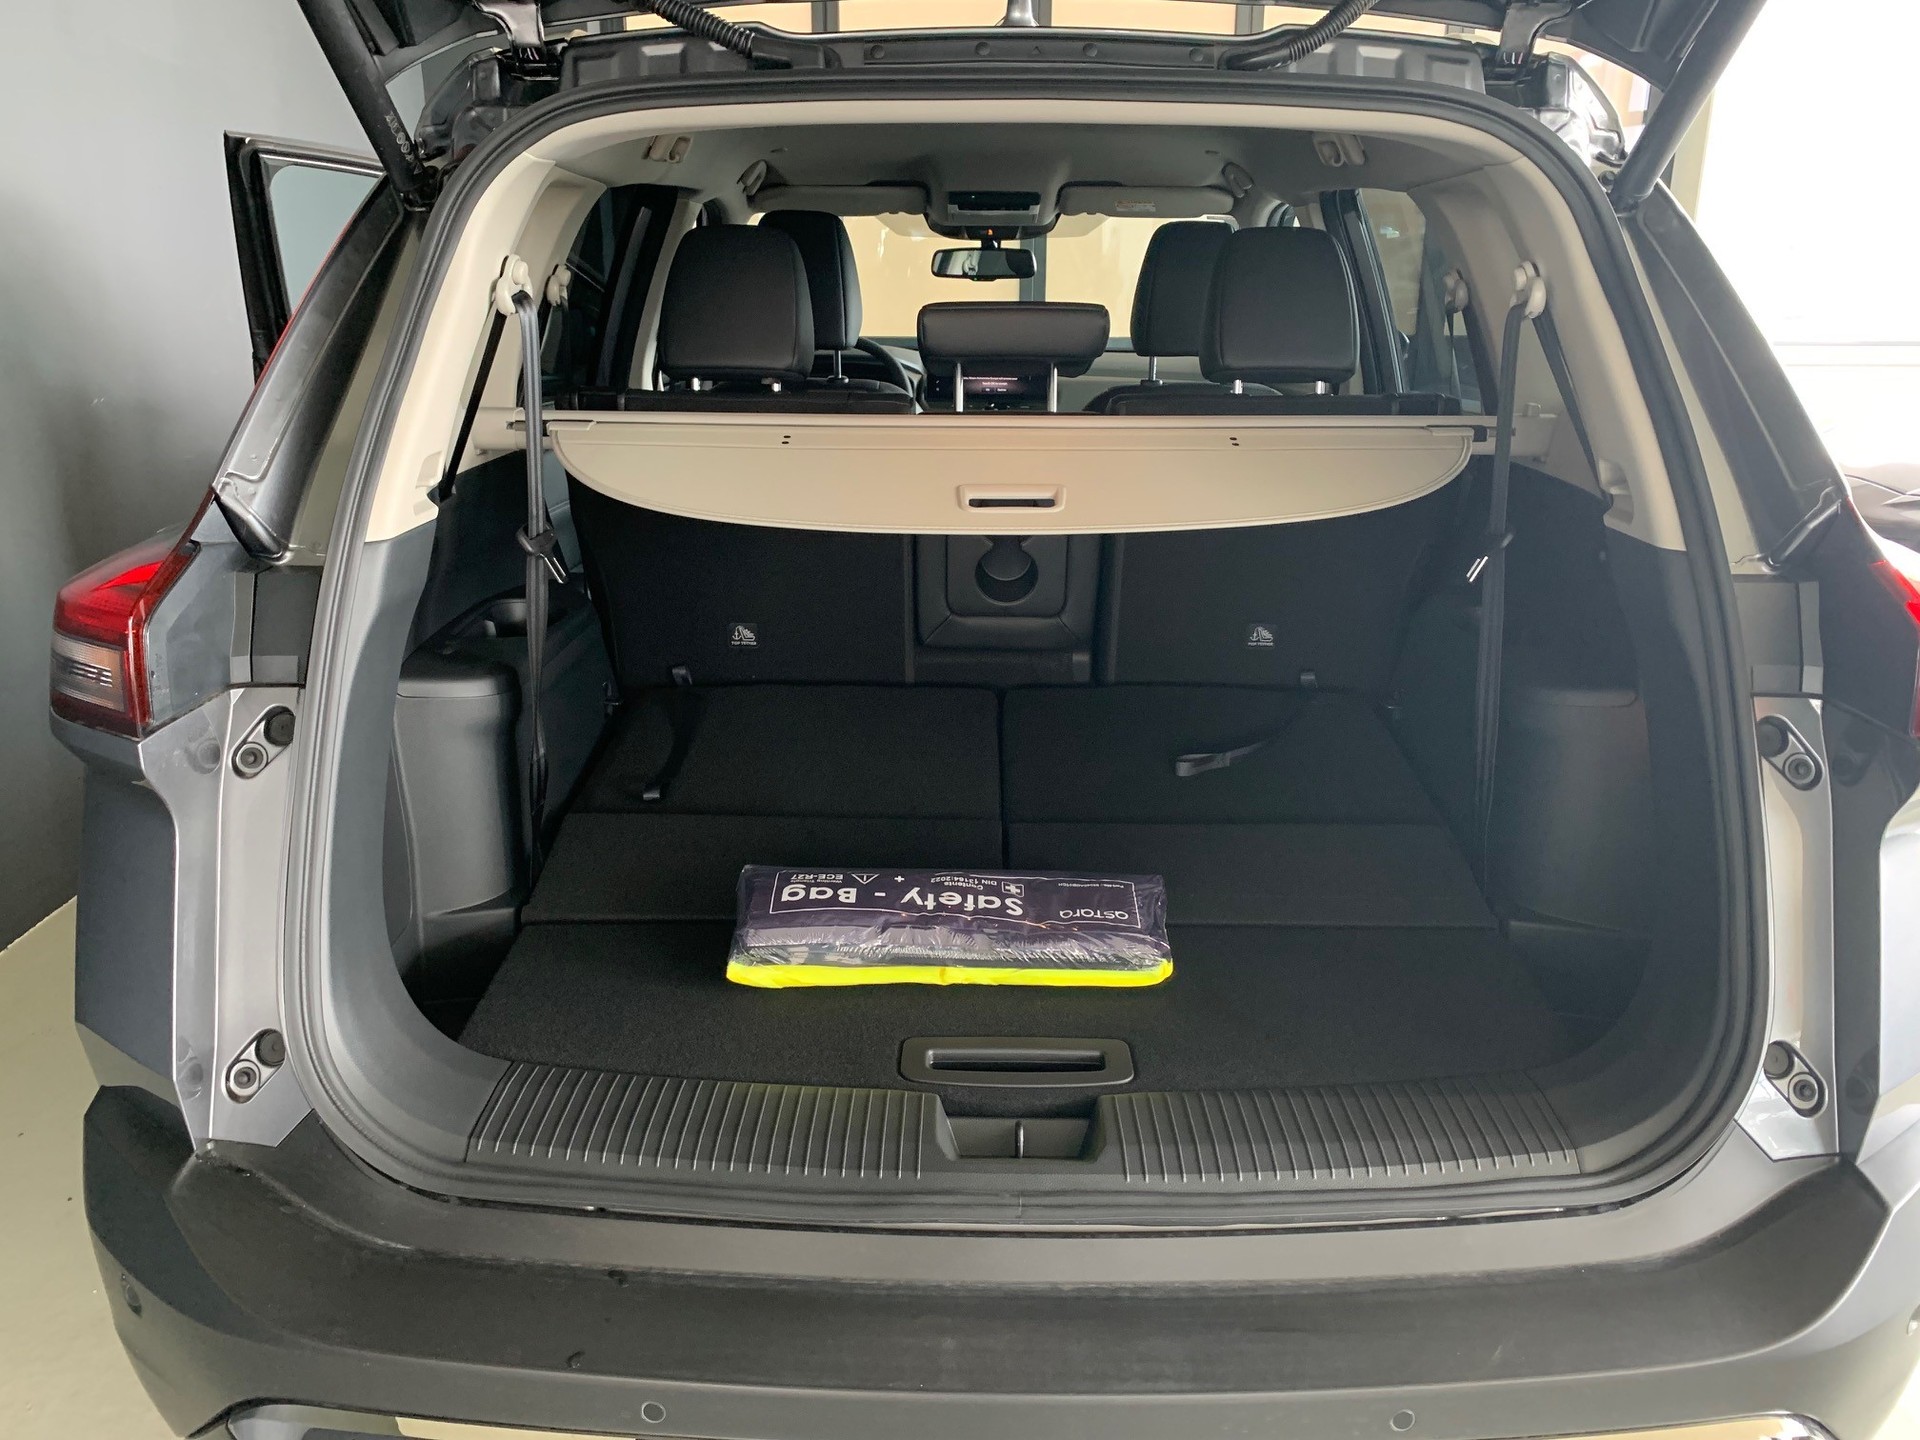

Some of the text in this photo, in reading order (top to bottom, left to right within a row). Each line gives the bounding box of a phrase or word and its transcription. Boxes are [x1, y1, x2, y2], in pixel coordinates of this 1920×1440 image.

[943, 880, 984, 891] Contents
[981, 878, 998, 886] DIN
[781, 884, 857, 904] Bag
[900, 887, 1023, 916] Safety
